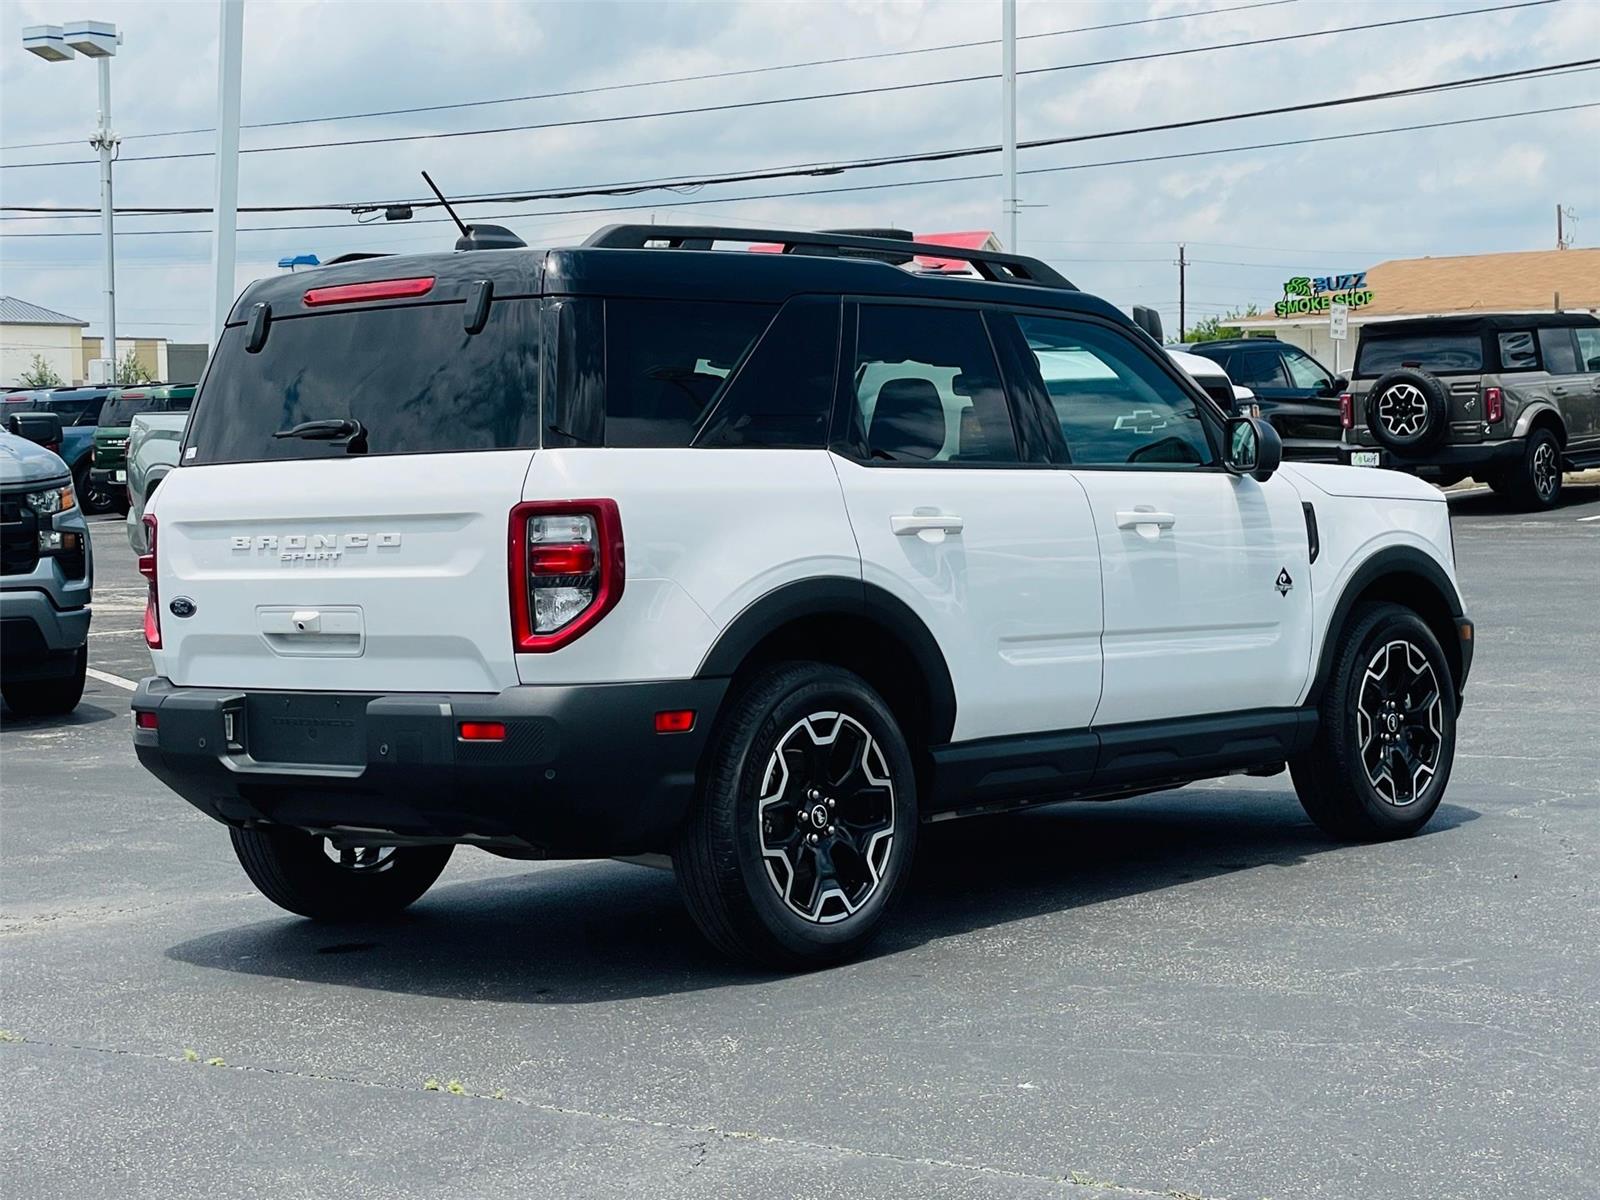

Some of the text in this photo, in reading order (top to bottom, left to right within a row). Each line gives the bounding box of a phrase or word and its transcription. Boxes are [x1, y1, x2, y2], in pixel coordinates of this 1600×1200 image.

[1314, 273, 1366, 292] BUZZ
[1276, 292, 1374, 315] SMOKE SHOP
[231, 534, 402, 551] BRONCO
[280, 552, 342, 562] SPORT
